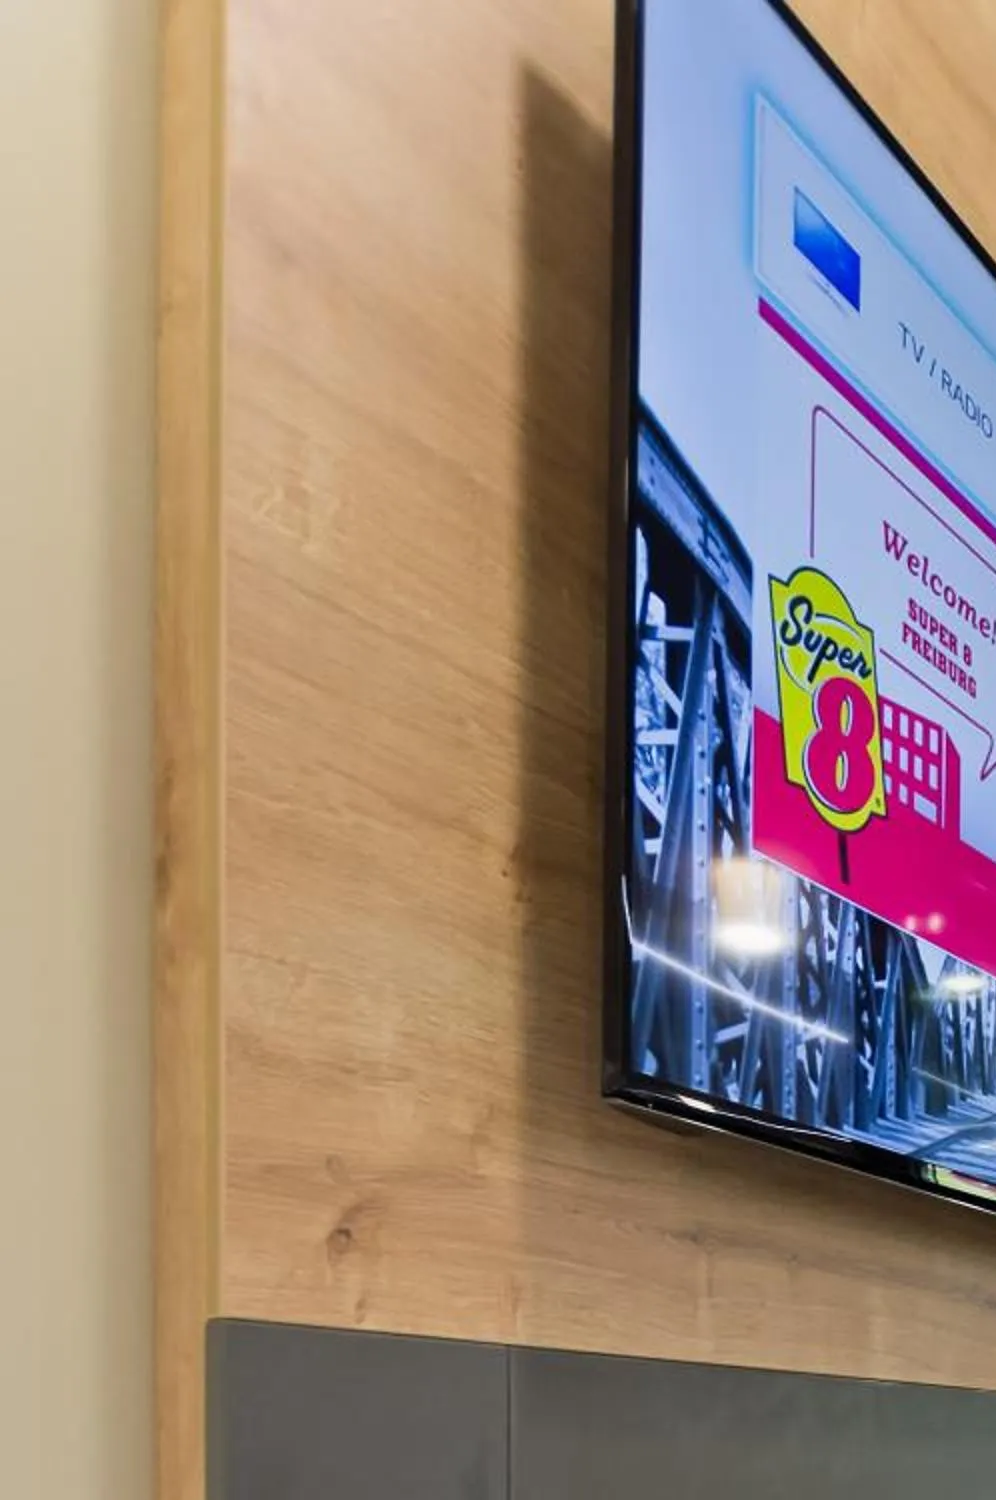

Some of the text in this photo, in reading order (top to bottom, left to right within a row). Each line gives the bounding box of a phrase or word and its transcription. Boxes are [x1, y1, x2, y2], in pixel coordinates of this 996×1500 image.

[898, 321, 993, 439] TV / RADIO
[780, 595, 872, 683] Super
[902, 621, 977, 699] FREIBURG
[908, 598, 973, 667] SUPER 8
[801, 677, 876, 814] 8
